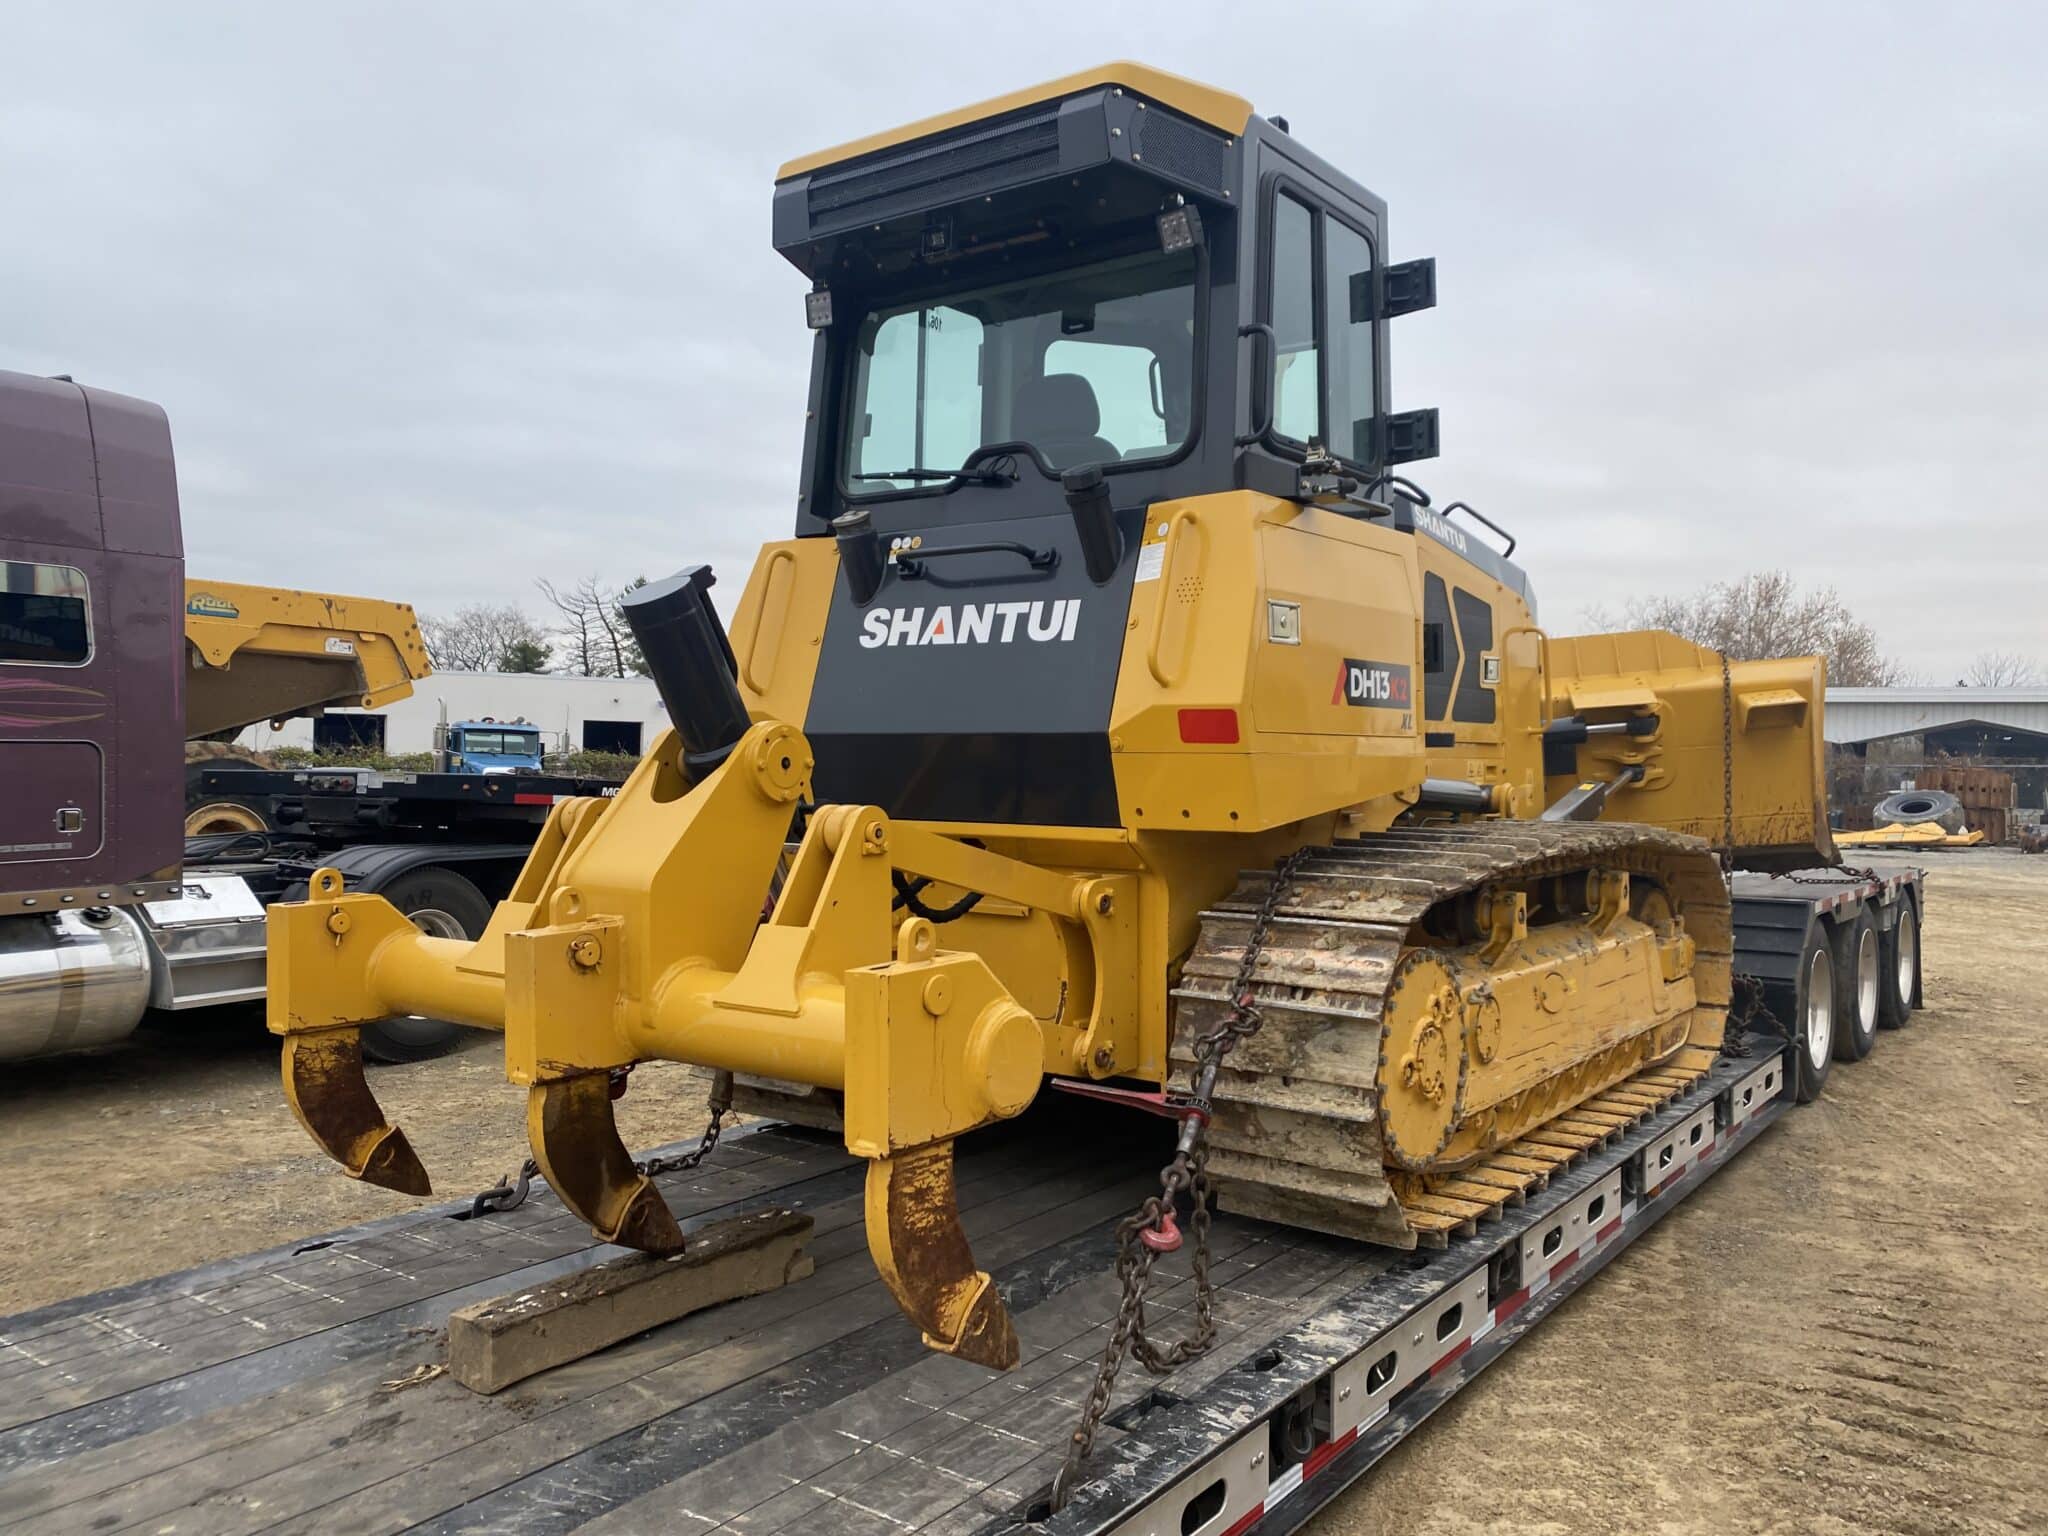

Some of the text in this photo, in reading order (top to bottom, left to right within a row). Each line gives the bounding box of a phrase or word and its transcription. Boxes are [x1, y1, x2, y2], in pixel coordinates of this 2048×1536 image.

[1414, 504, 1468, 554] SHANTUI
[859, 598, 1082, 649] SHANTUI
[1400, 713, 1413, 730] XL
